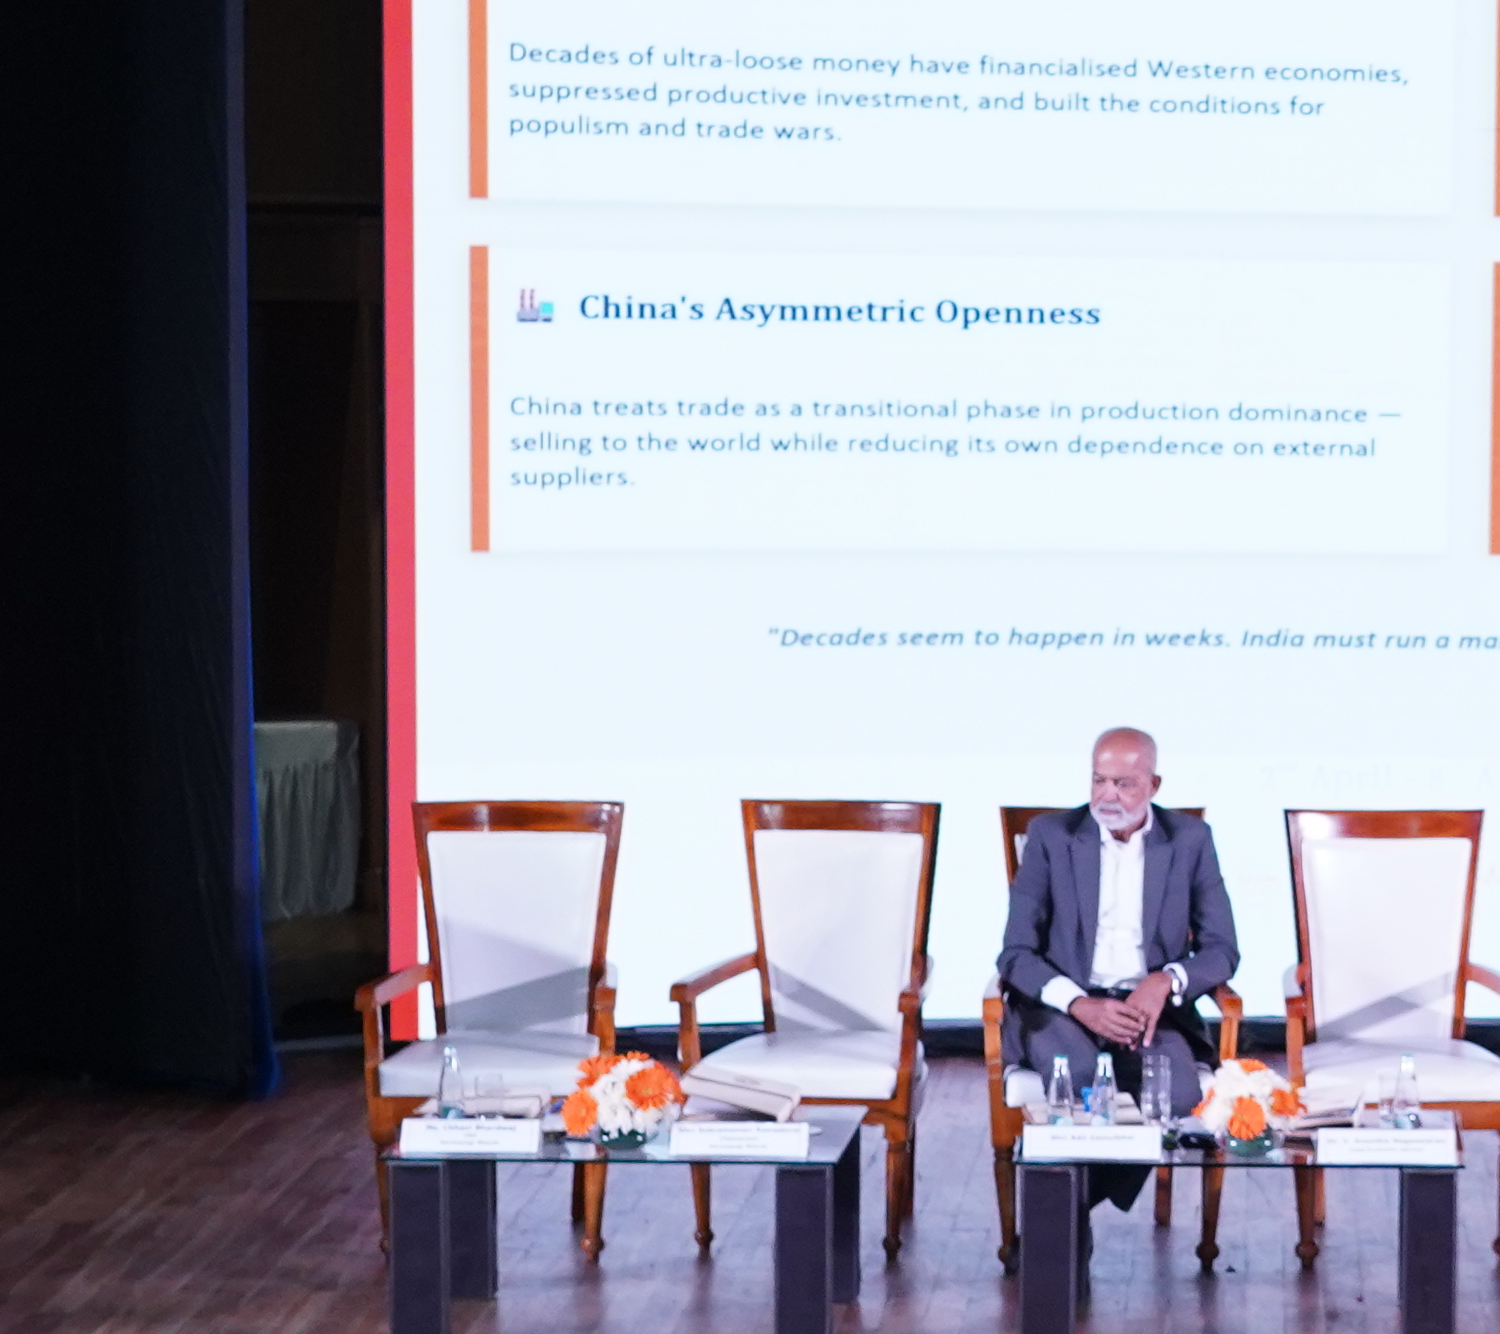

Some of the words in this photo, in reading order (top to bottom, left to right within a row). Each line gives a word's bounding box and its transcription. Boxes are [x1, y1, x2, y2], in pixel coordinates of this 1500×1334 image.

[508, 40, 622, 66] Decades
[626, 44, 656, 67] of
[662, 46, 805, 72] ultra-loose
[811, 55, 902, 78] money
[908, 52, 972, 76] have
[977, 54, 1139, 79] financialised
[1145, 59, 1257, 81] Western
[1262, 65, 1410, 86] economies,
[507, 82, 659, 104] suppressed
[666, 84, 809, 108] productive
[815, 90, 970, 112] investment,
[976, 90, 1026, 112] and
[1032, 90, 1092, 113] built
[1097, 91, 1142, 114] the
[1147, 94, 1283, 116] conditions
[1288, 93, 1326, 117] for
[508, 114, 630, 138] populism
[636, 116, 687, 139] and
[694, 118, 766, 141] trade
[772, 125, 842, 142] wars.
[578, 293, 706, 321] China's
[714, 297, 926, 328] Asymmetric
[934, 299, 1102, 331] Openness
[508, 394, 584, 417] China
[590, 398, 670, 418] treats
[675, 396, 747, 418] trade
[753, 401, 782, 418] as
[788, 401, 804, 419] a
[810, 399, 959, 419] transitional
[965, 398, 1042, 423] phase
[1049, 401, 1073, 420] in
[1079, 400, 1221, 423] production
[1226, 402, 1369, 424] dominance
[509, 430, 594, 458] selling
[599, 434, 629, 453] to
[634, 430, 680, 453] the
[685, 431, 762, 453] world
[768, 431, 840, 454] while
[847, 433, 960, 459] reducing
[966, 435, 998, 455] its
[1003, 438, 1060, 455] own
[1066, 434, 1225, 457] dependence
[1231, 440, 1266, 457] on
[1271, 438, 1377, 458] external
[509, 465, 635, 491] suppliers.
[767, 626, 890, 648] "Decades
[895, 630, 966, 648] seem
[972, 628, 1002, 648] to
[1006, 626, 1106, 651] happen
[1111, 626, 1137, 647] in
[1143, 627, 1232, 649] weeks.
[1240, 628, 1307, 649] India
[1311, 631, 1379, 650] must
[1383, 633, 1429, 650] run
[1433, 634, 1452, 651] a
